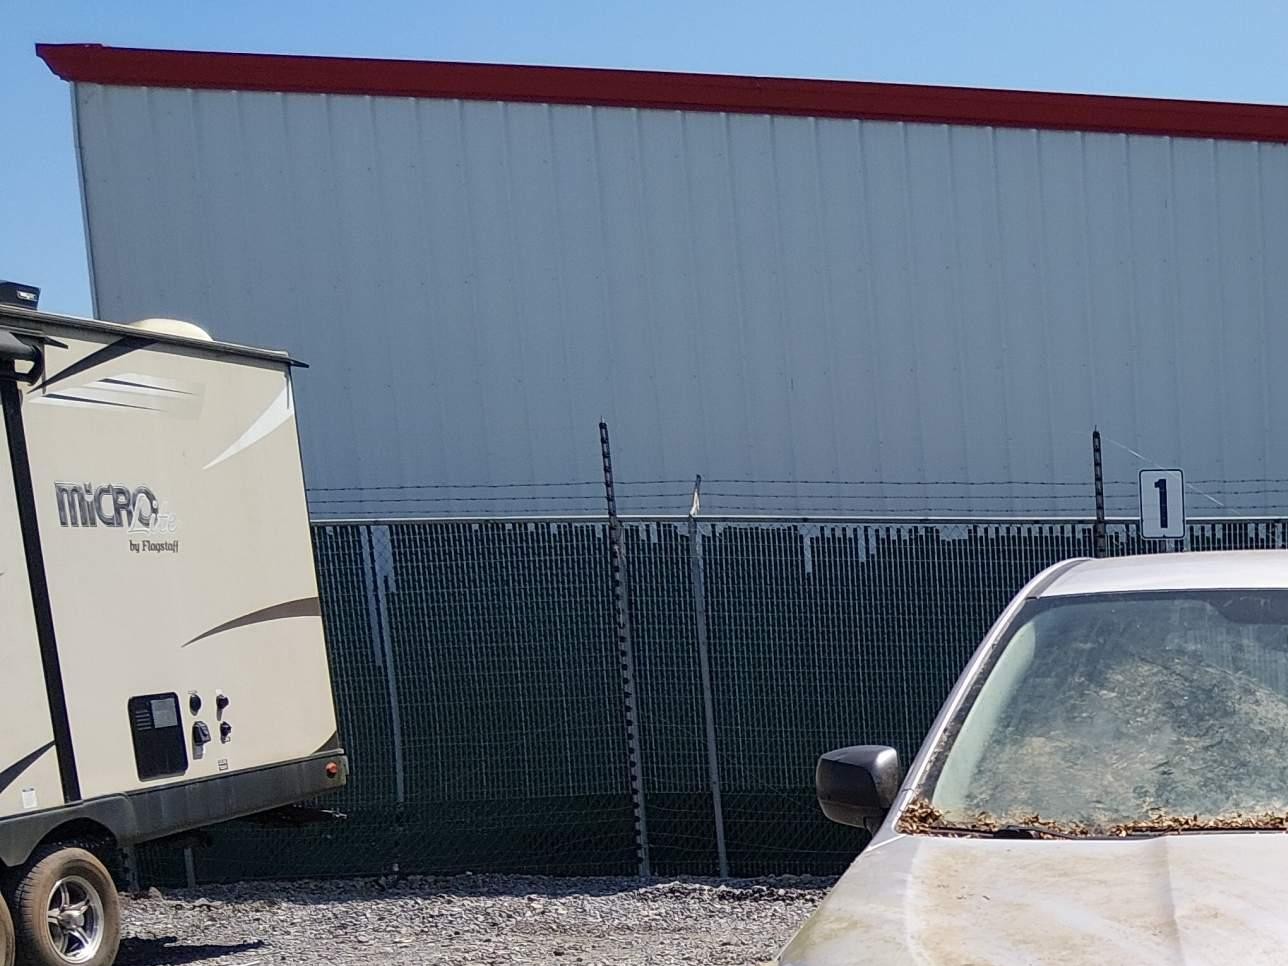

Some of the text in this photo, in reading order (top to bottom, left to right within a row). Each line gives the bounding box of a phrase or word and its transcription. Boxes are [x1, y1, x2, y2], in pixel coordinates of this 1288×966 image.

[1154, 479, 1168, 528] 1
[129, 540, 179, 553] by Flagstaff
